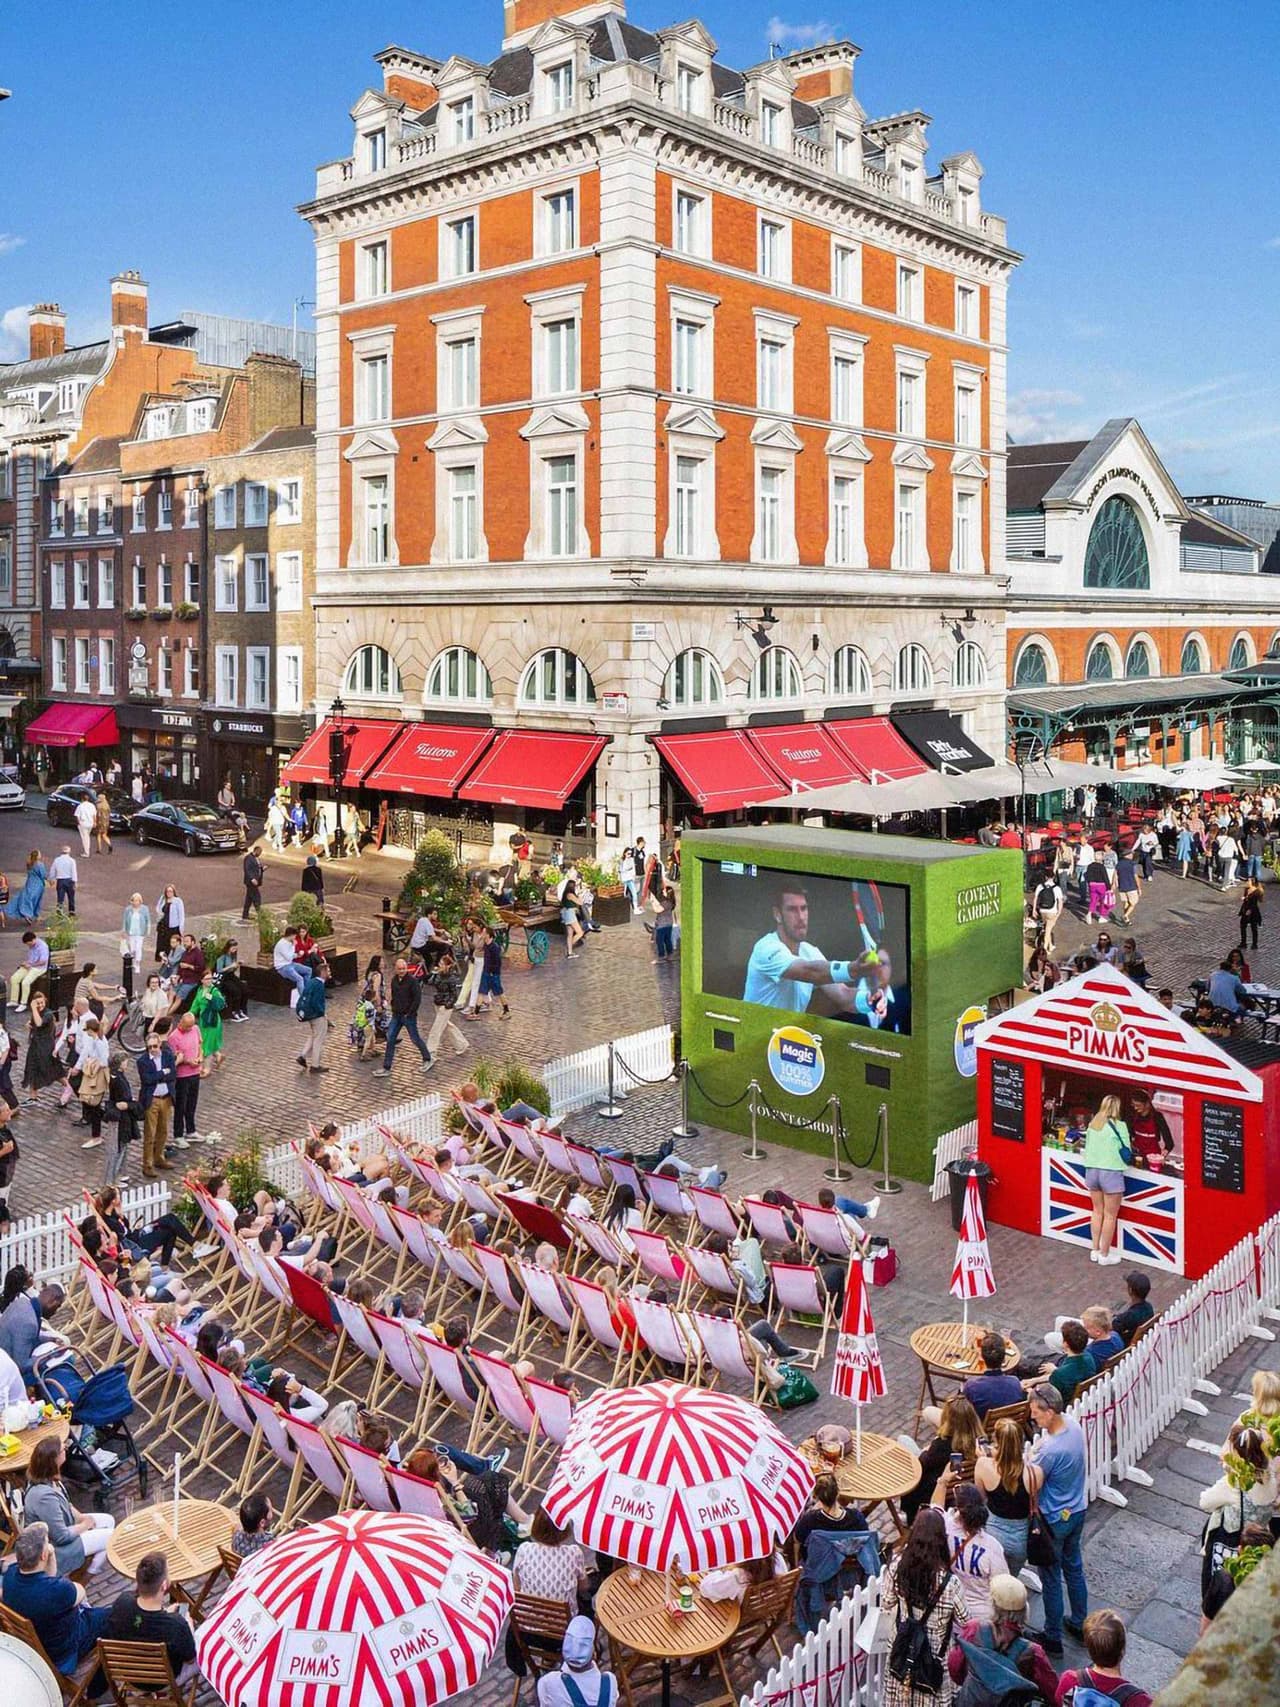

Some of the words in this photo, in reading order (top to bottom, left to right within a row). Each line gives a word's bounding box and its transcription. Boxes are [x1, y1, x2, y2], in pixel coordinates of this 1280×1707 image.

[1086, 473, 1108, 514] LONDON
[1107, 467, 1141, 485] TRANSPORT
[228, 723, 264, 733] STARBUCKS
[415, 743, 458, 758] Tuttons
[957, 882, 1000, 907] COVENT
[957, 898, 1000, 924] GARDEN
[782, 1044, 814, 1063] Magic
[1070, 1026, 1145, 1062] PIMM'S
[779, 1062, 812, 1080] 100%
[760, 1455, 784, 1491] PIMM'S
[611, 1495, 656, 1521] PIMM'S
[697, 1496, 741, 1524] PIMM'S
[460, 1570, 485, 1611] PIMM'S
[230, 1617, 258, 1655] PIMM'S
[389, 1627, 440, 1667] PIMM'S
[289, 1653, 340, 1678] PIMM'S
